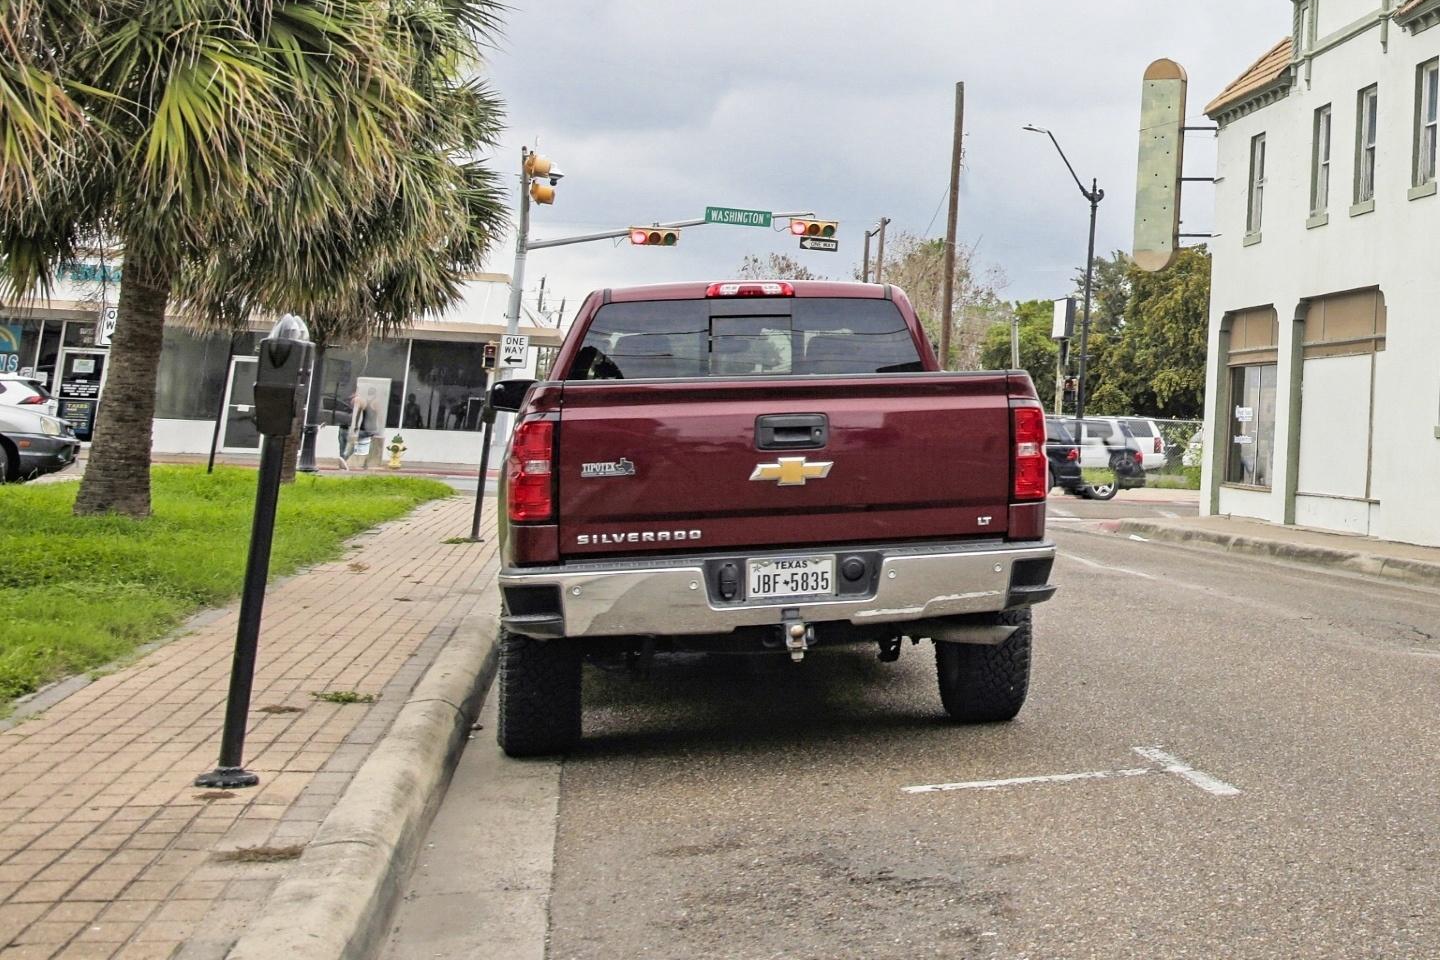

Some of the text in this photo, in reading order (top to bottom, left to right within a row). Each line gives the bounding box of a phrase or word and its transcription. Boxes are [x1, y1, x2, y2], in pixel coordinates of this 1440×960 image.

[711, 209, 764, 224] WASHINGTON
[506, 337, 525, 345] ONE
[505, 346, 525, 354] WAY
[582, 462, 616, 473] TIPOTEX
[977, 516, 993, 526] LT
[577, 530, 702, 545] SILVERADO
[774, 560, 808, 570] TEXAS
[752, 571, 829, 594] JBF 5835
